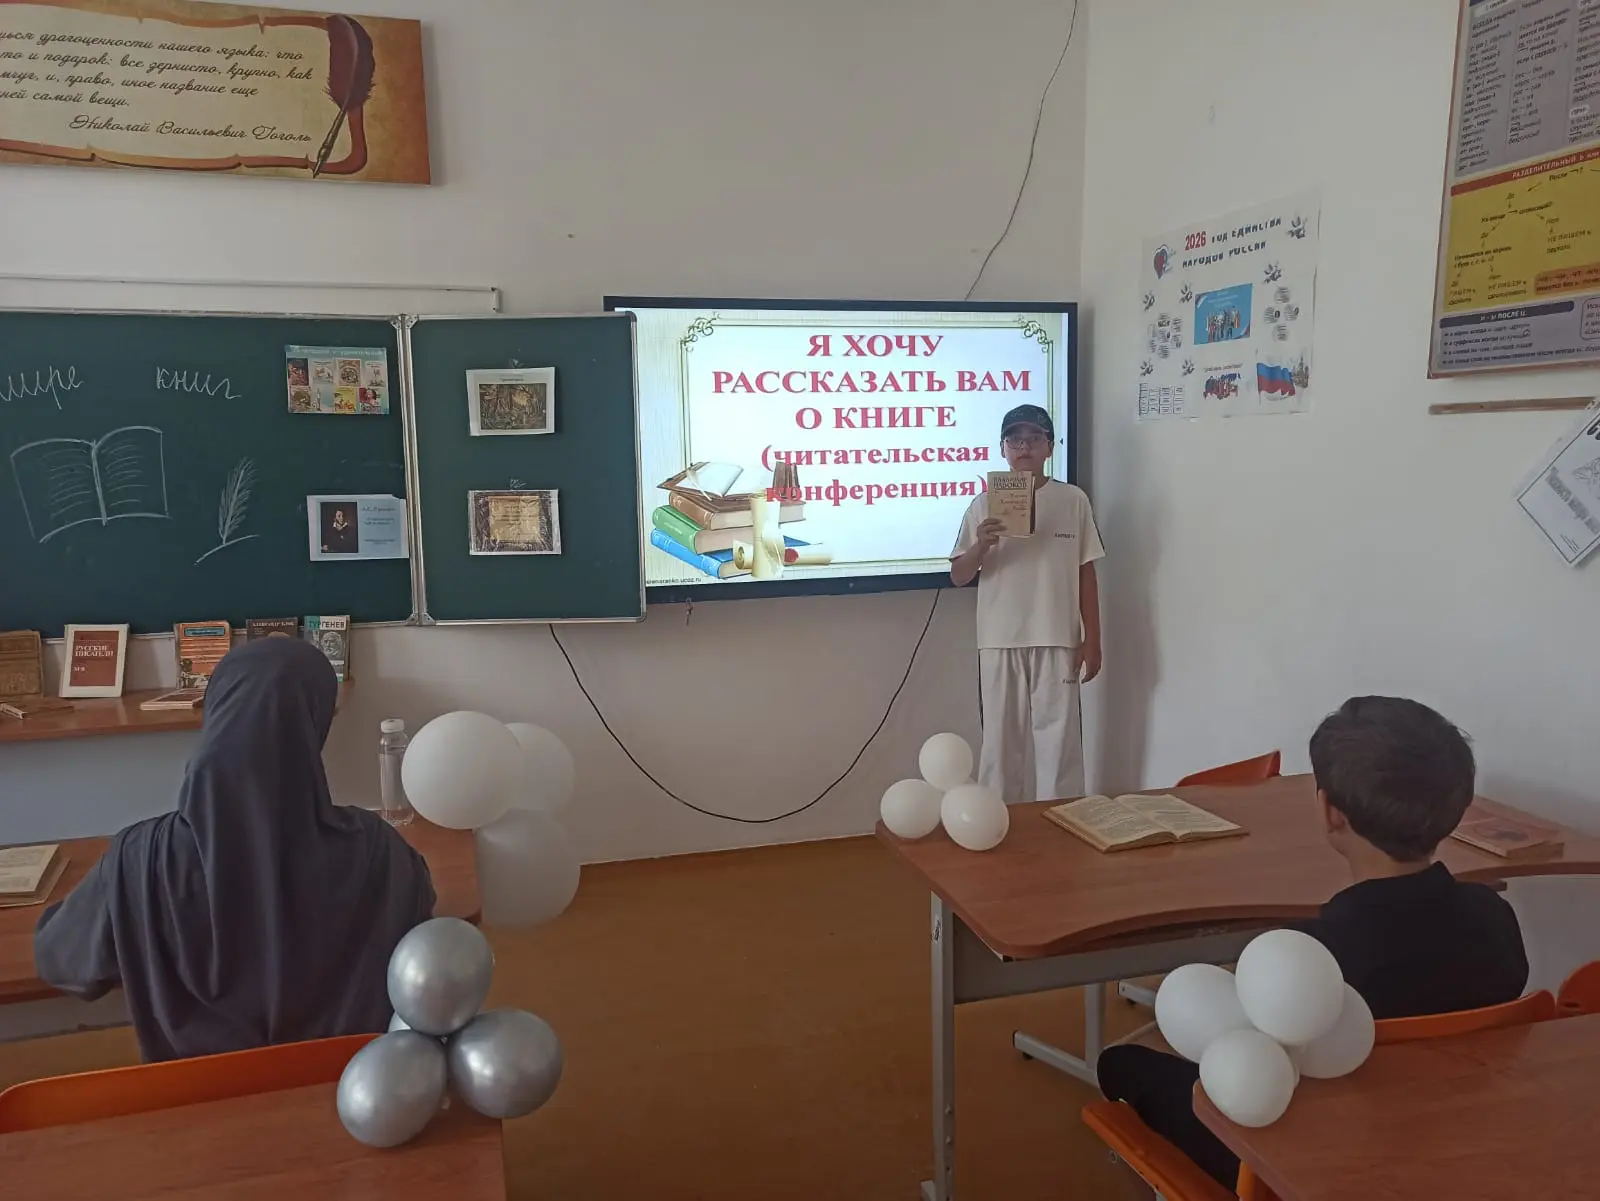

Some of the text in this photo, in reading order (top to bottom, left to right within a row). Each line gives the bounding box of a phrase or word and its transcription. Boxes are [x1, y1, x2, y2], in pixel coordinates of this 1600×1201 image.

[36, 31, 153, 49] драгоценности
[157, 41, 212, 54] нашего
[216, 44, 268, 60] языка:
[276, 49, 304, 61] что
[28, 52, 40, 60] и
[43, 52, 113, 69] подарок:
[120, 53, 146, 69] все
[227, 62, 280, 80] крупно,
[285, 66, 314, 81] как
[64, 72, 115, 88] право,
[121, 79, 155, 88] иное
[160, 78, 227, 95] название
[231, 86, 259, 98] еще
[32, 91, 84, 103] самой
[89, 91, 130, 108] вещи.
[68, 113, 313, 142] Николай Васильевич Гоголь
[1512, 152, 1577, 178] РАЗДЕЛИТЕЛЬНЫЙ
[1184, 230, 1207, 251] 2026
[1182, 240, 1266, 269] НАРОДОВ РОССИИ
[1498, 311, 1519, 320] ПОСЛЕ
[806, 334, 944, 358] Я ХОЧУ
[156, 366, 242, 400] книг
[712, 369, 1032, 394] РАССКАЗАТЬ ВАМ
[795, 405, 957, 430] О КНИГЕ
[761, 444, 989, 473] (читательская
[765, 474, 988, 507] конференция)
[308, 619, 345, 629] ТУРГЕНЕВ
